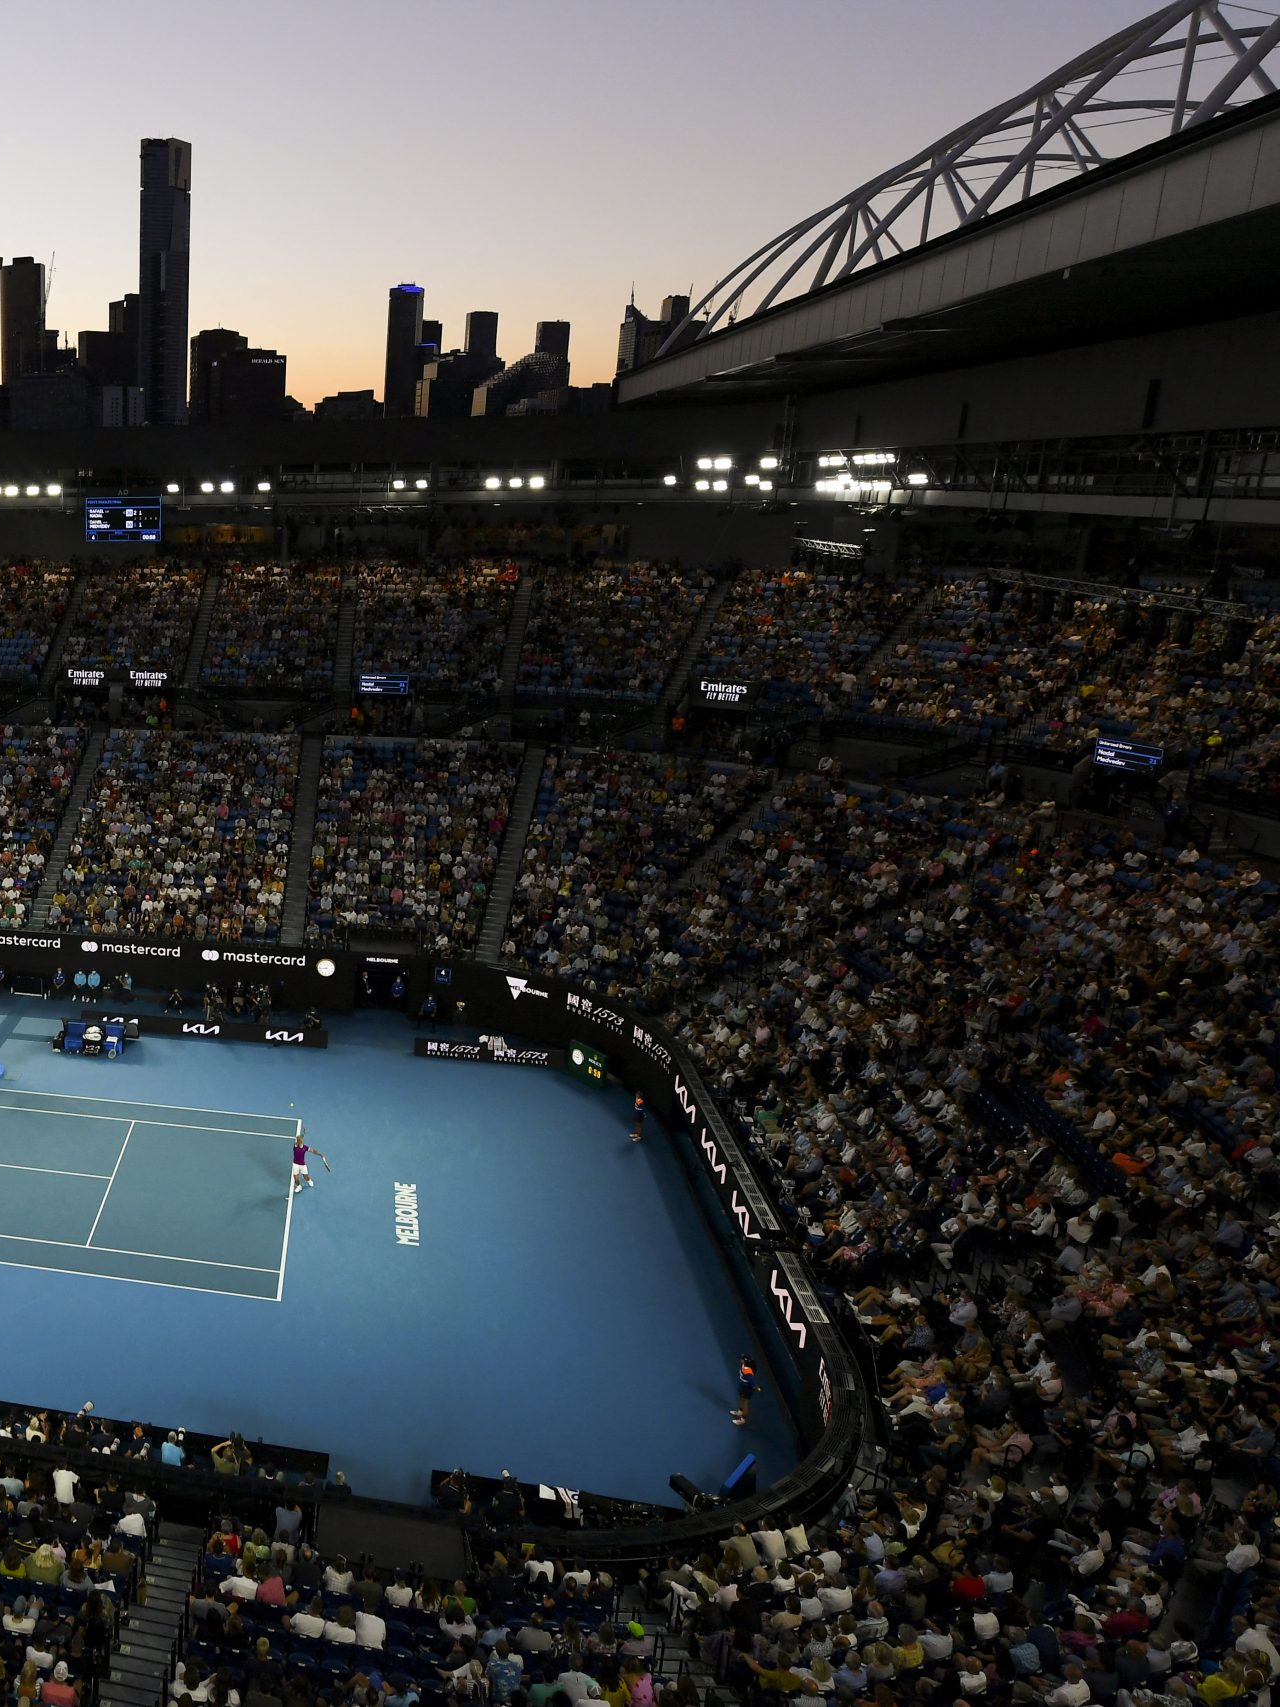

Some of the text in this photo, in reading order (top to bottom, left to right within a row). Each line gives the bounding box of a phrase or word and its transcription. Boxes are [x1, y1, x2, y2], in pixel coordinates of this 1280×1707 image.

[67, 669, 105, 679] Emirates
[129, 670, 168, 680] Emirates
[700, 681, 748, 694] Emirates
[706, 691, 740, 702] FLY BETTER
[101, 942, 181, 958] mastercard
[223, 950, 306, 967] mastercard
[394, 1181, 420, 1246] MELBOURNE
